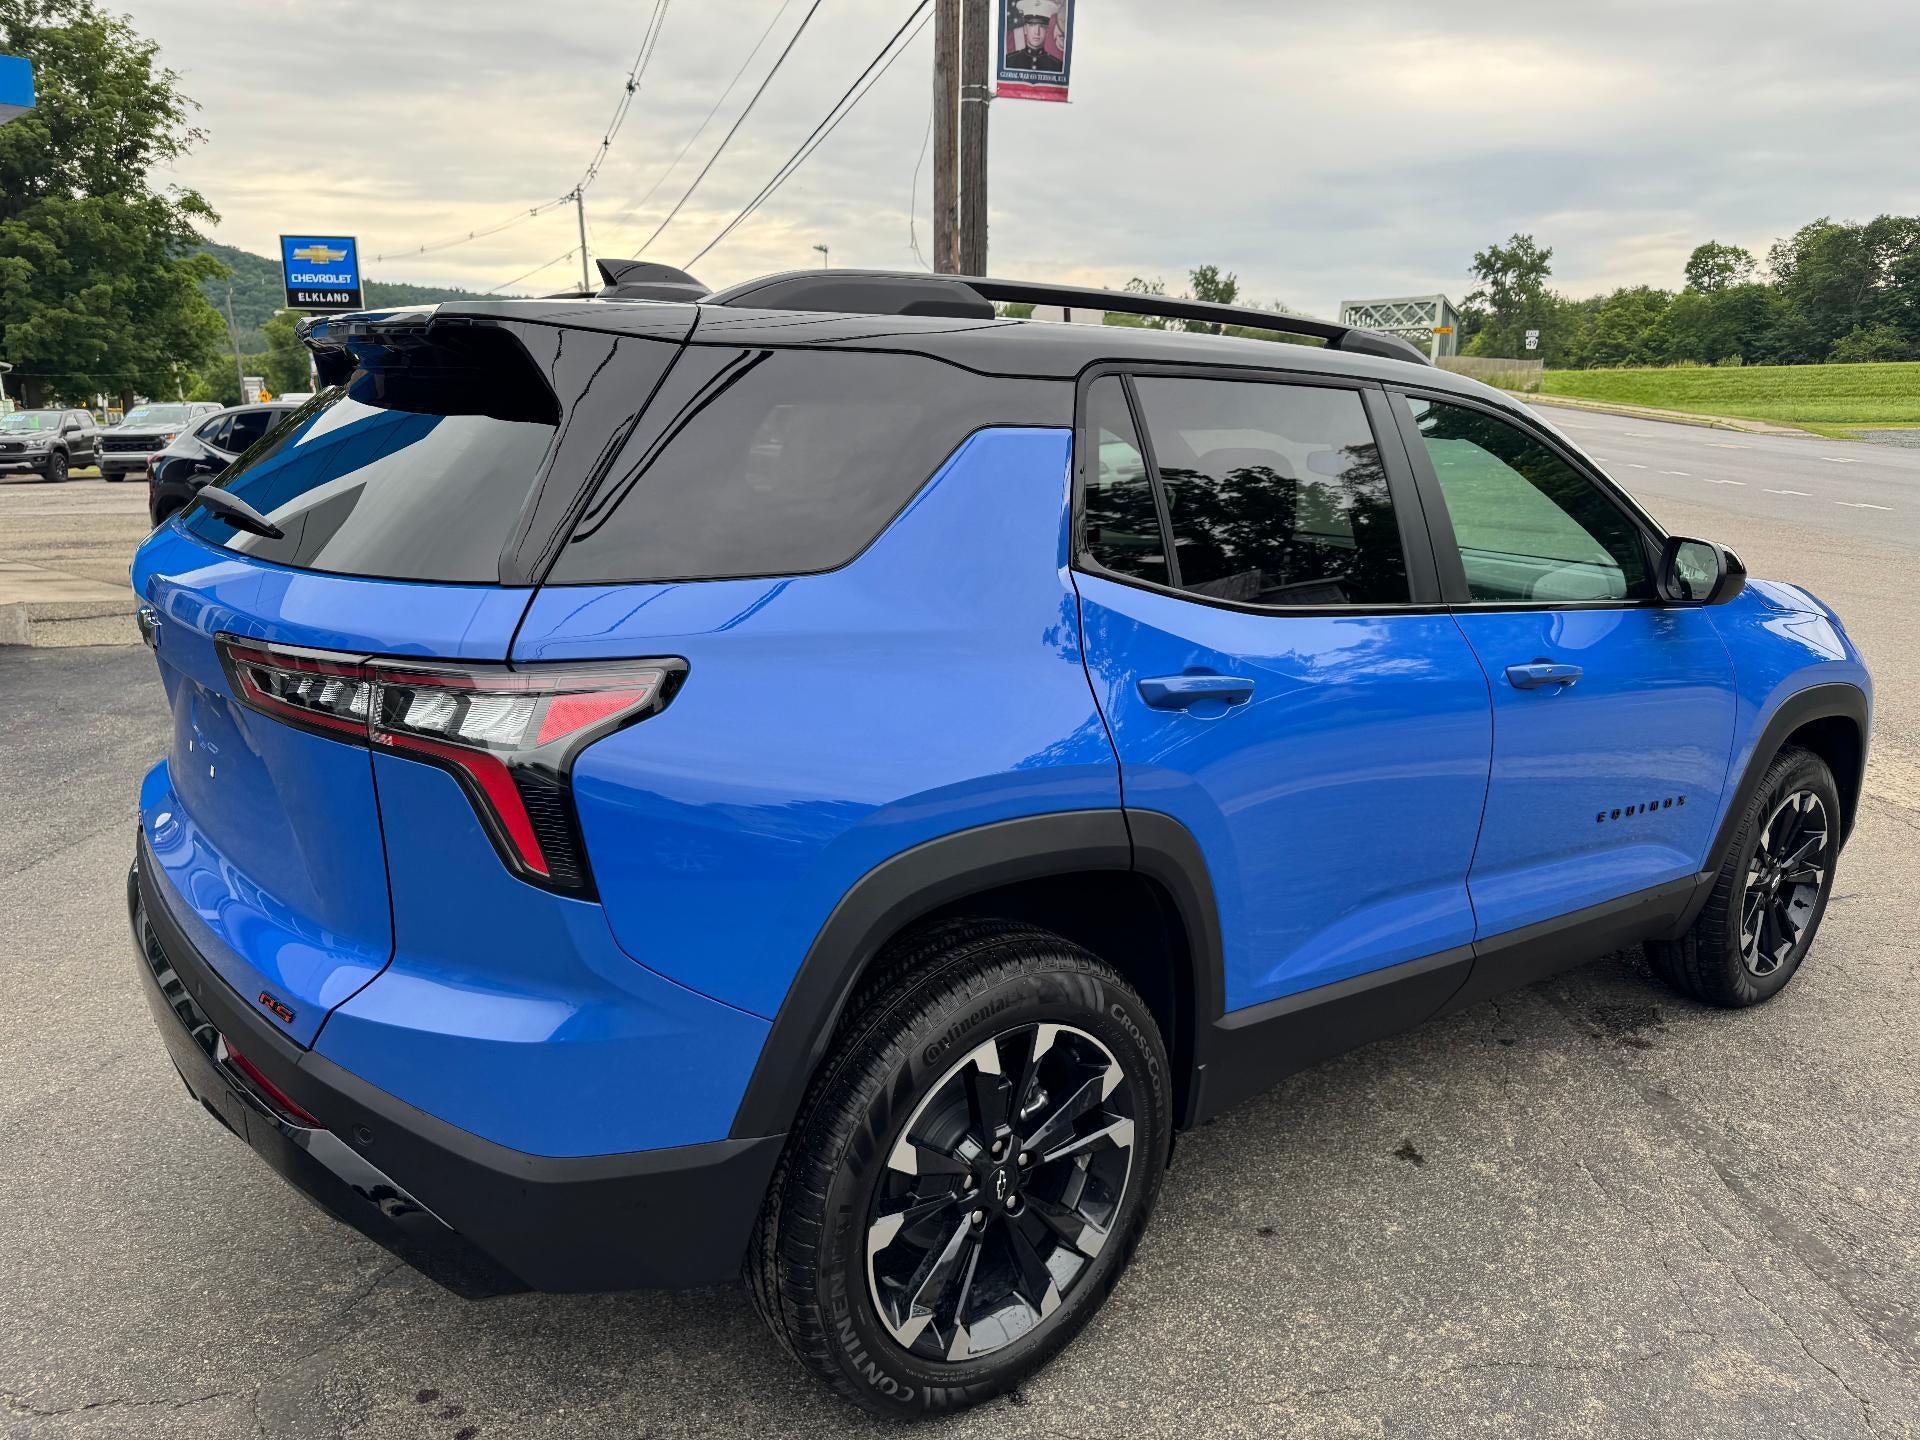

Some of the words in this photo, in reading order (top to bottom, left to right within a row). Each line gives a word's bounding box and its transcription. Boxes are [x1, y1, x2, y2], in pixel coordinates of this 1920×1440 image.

[291, 273, 352, 284] CHEVROLET
[298, 291, 350, 303] ELKLAND
[1526, 339, 1537, 347] 49
[1596, 795, 1686, 823] EQUINOX
[259, 991, 295, 1023] RS
